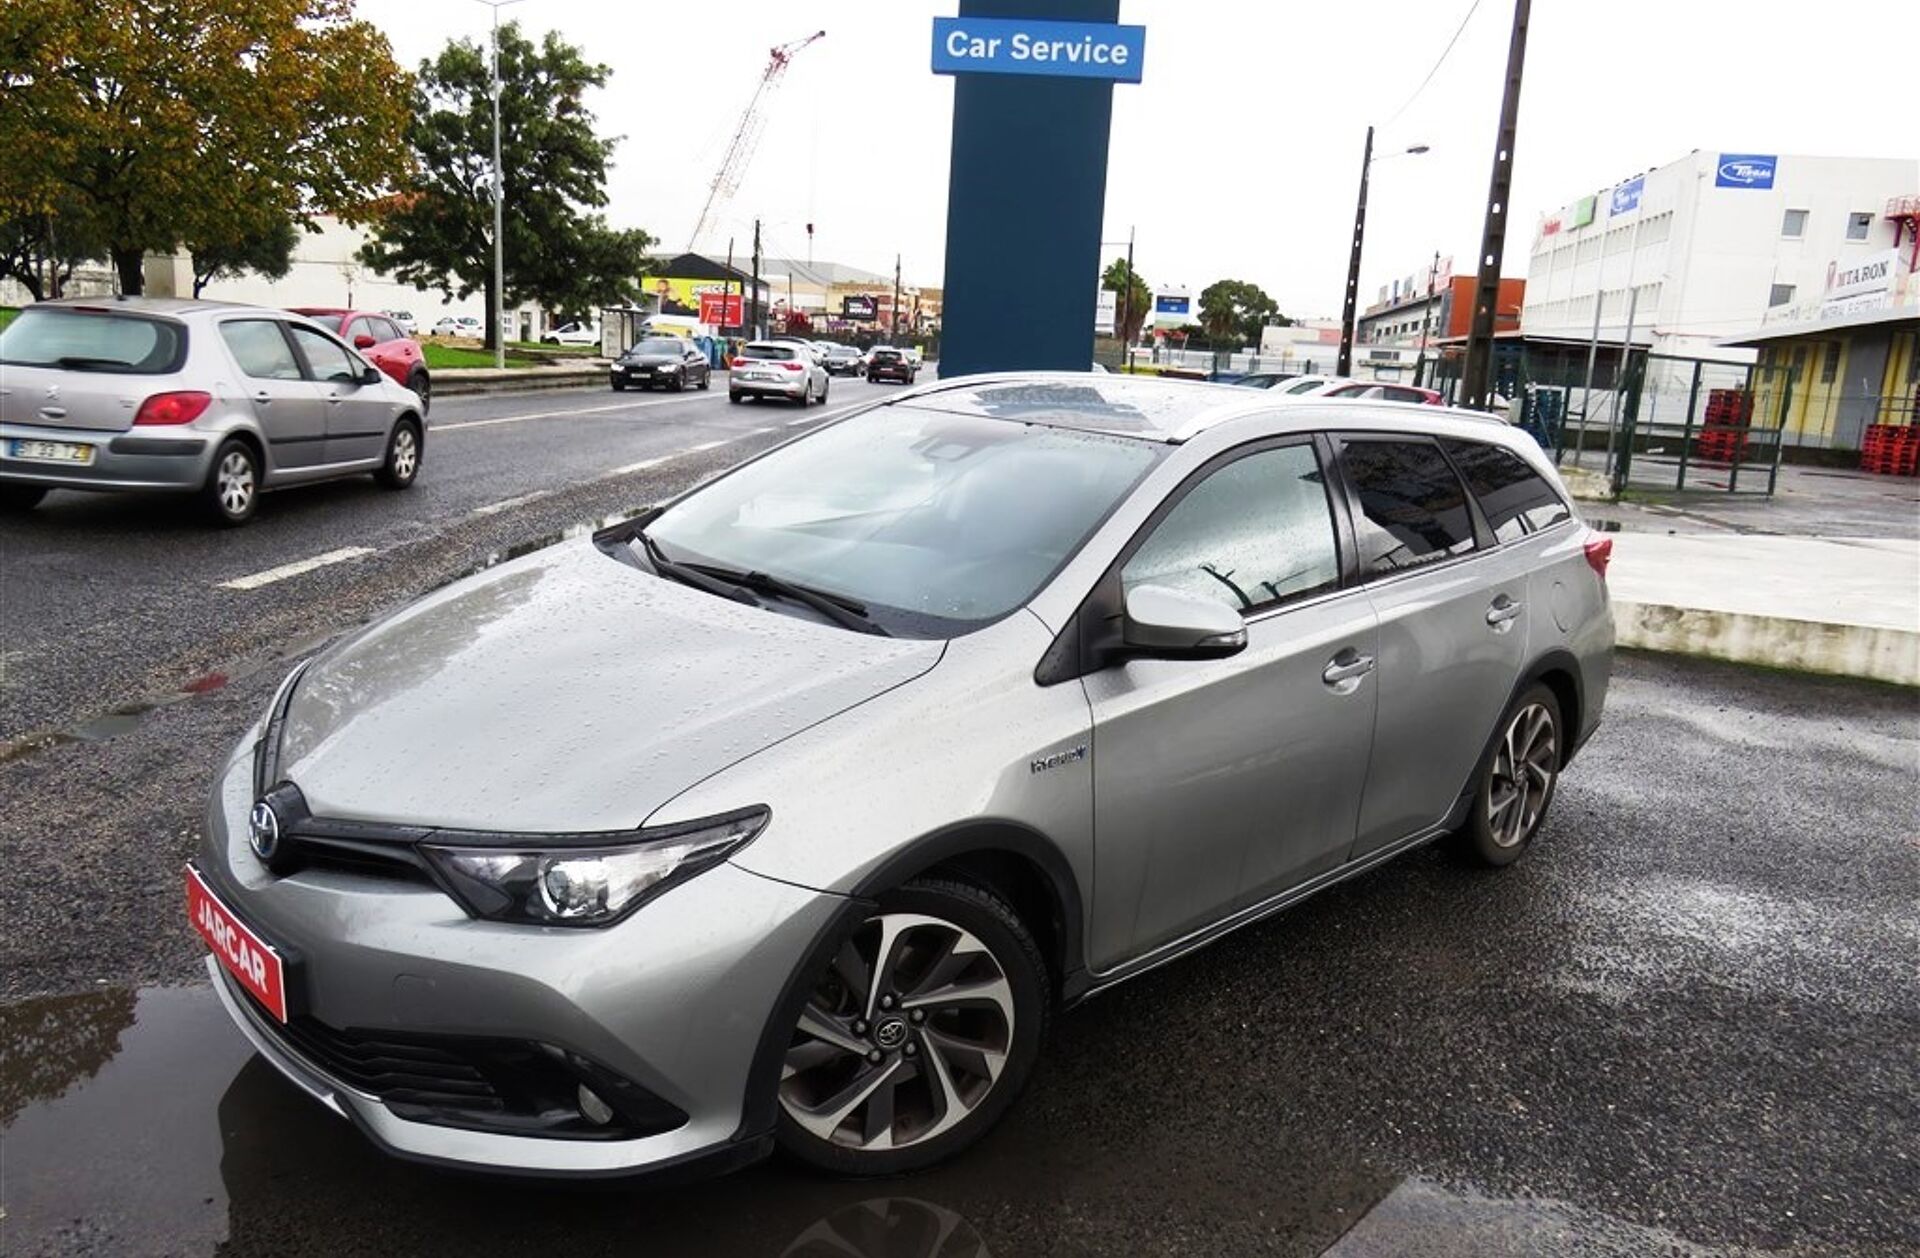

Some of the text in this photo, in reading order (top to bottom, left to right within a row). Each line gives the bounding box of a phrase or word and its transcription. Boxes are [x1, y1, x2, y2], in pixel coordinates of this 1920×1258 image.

[946, 31, 1129, 64] Car Service
[198, 898, 268, 994] JARCAR
